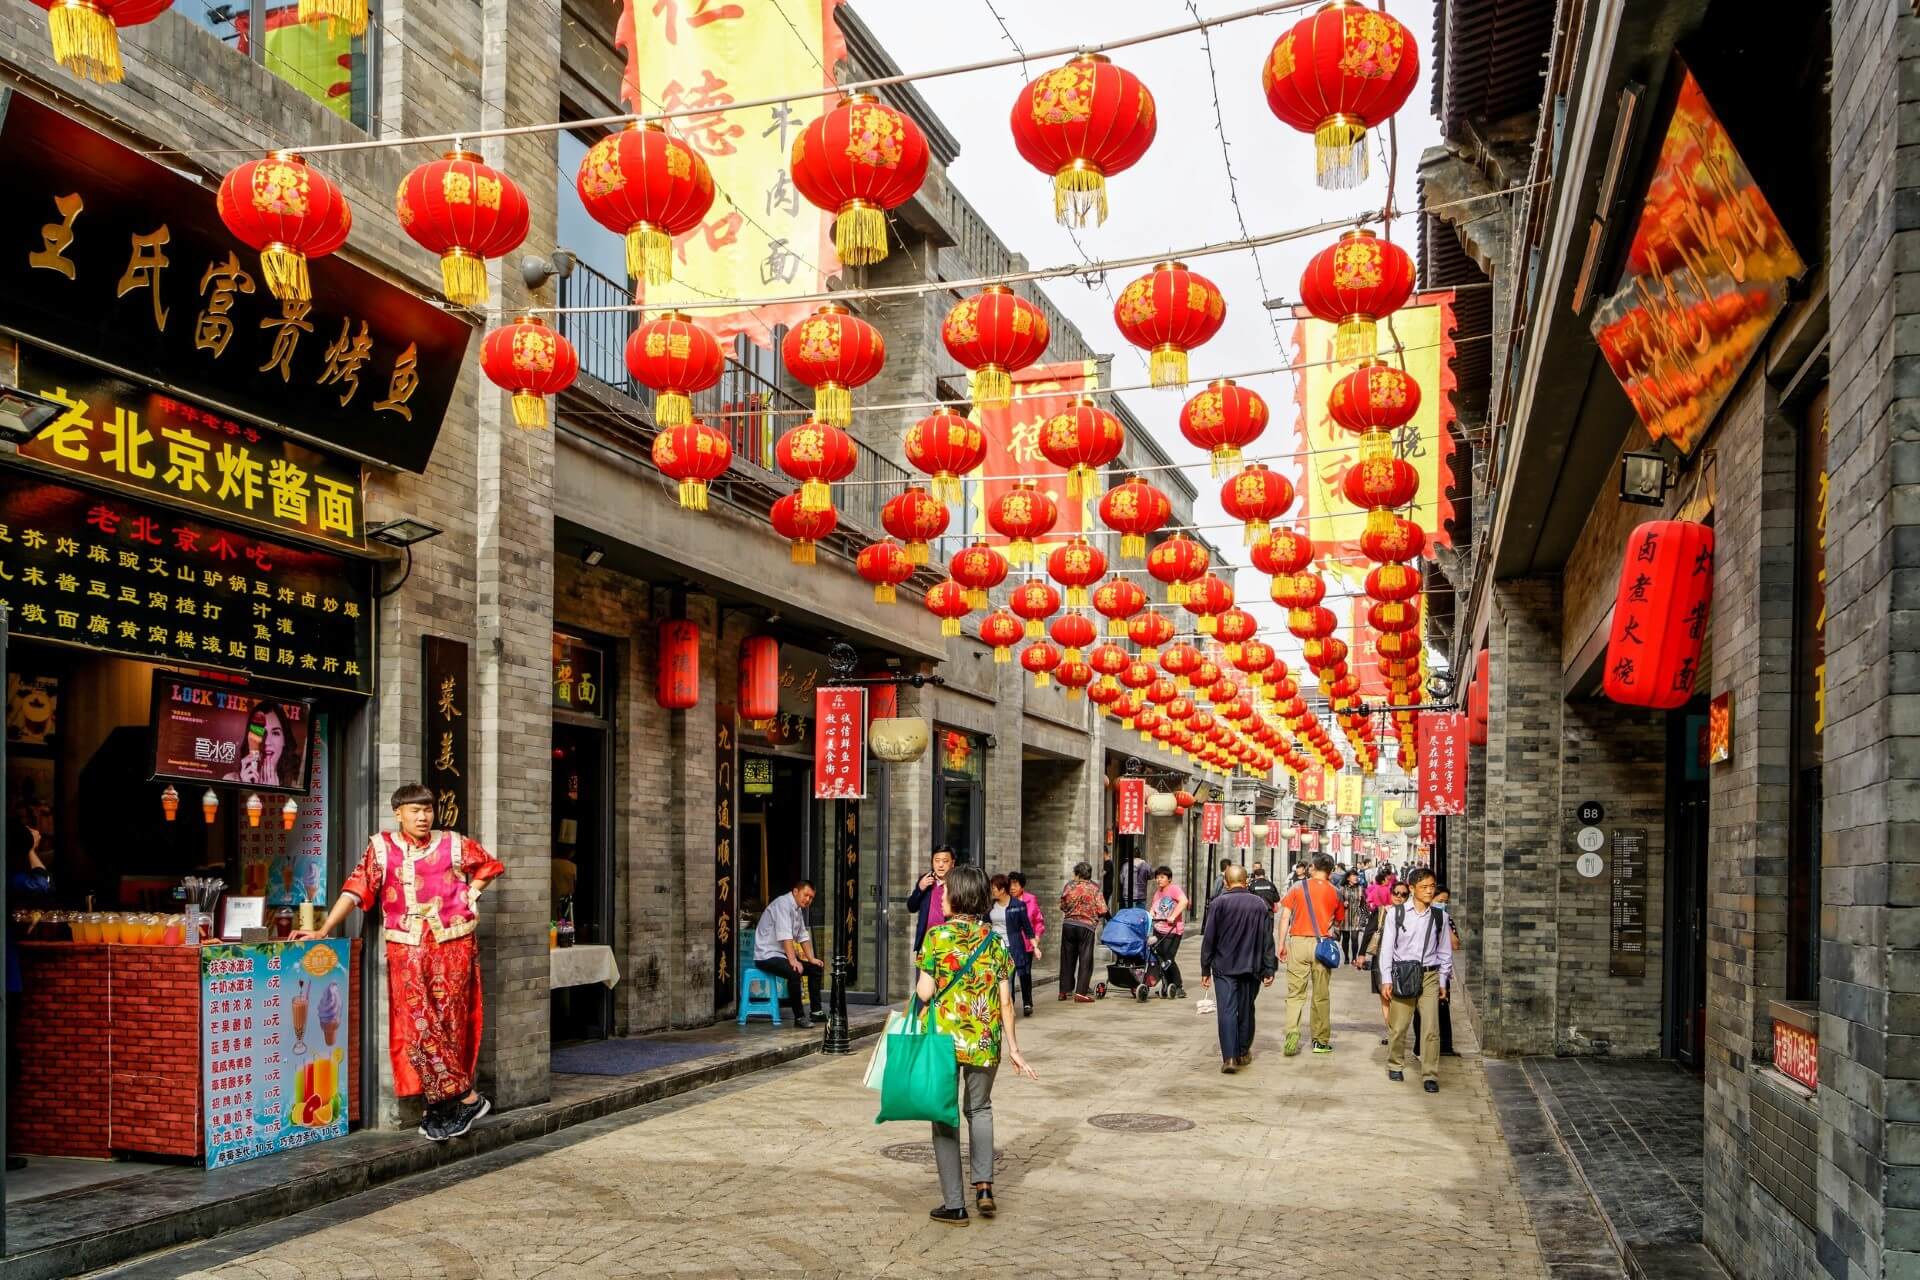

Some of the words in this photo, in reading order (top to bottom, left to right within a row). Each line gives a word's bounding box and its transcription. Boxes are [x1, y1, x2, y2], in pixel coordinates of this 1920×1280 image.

[759, 100, 803, 285] 牛肉面
[28, 192, 420, 422] 王氏富贵烤鱼
[37, 386, 355, 538] 老北京炸酱面
[86, 505, 273, 572] 老北京小吃
[1612, 531, 1658, 685] 卤煮火烧
[171, 684, 213, 706] LOCK
[216, 691, 248, 712] THE
[1583, 808, 1598, 819] B8
